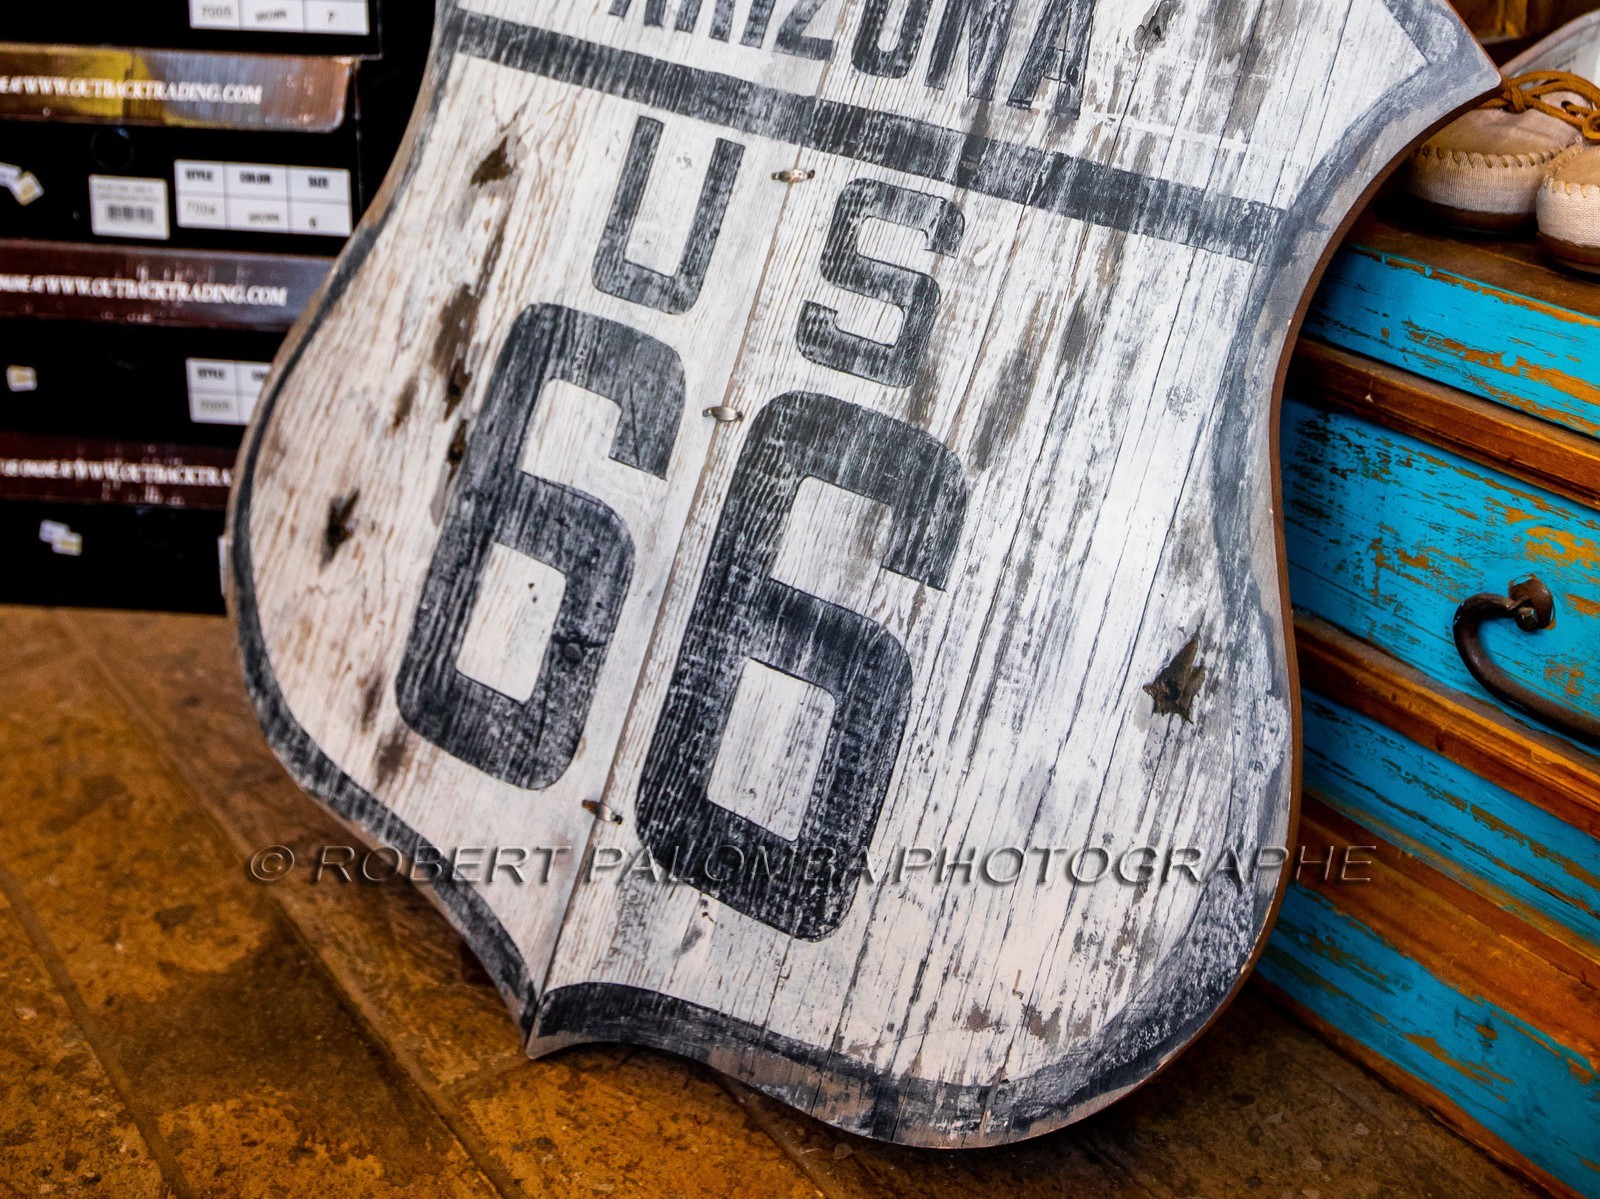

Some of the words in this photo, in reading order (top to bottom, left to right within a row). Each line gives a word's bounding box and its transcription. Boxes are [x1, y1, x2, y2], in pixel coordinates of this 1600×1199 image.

[23, 75, 263, 105] WWW.OUTBACKTRADING.COM
[185, 169, 213, 183] STYLE
[239, 172, 272, 185] COLOR
[307, 176, 330, 189] SIZE
[45, 274, 288, 307] WWW.OUTBACKTRADING.COM
[73, 459, 235, 487] WWW.OUTBACKTRA
[395, 302, 967, 943] 66
